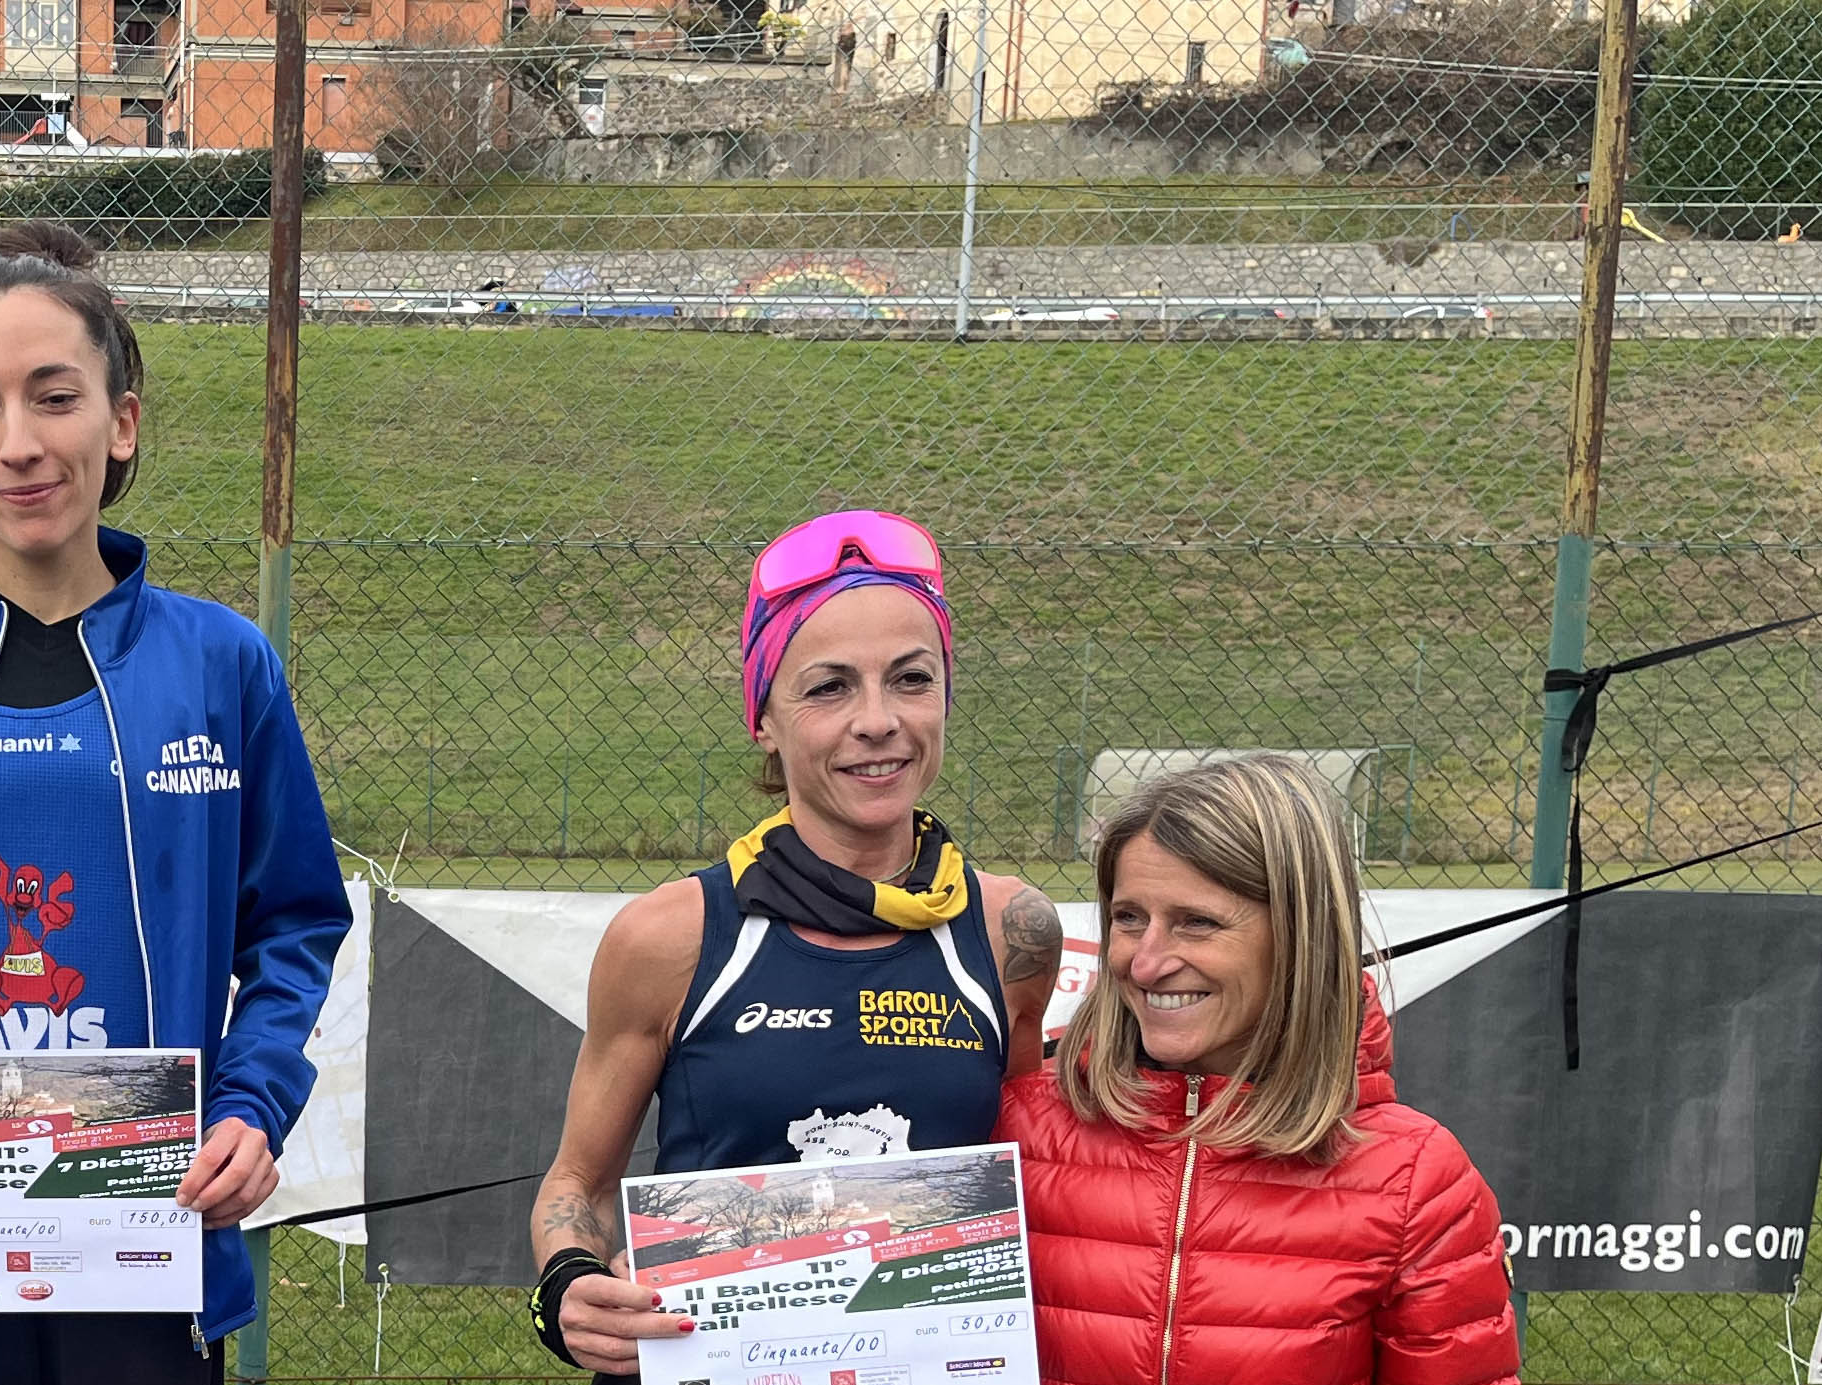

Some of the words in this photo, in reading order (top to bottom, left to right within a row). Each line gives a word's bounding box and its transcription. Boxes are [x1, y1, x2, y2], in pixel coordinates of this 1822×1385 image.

[859, 990, 948, 1016] BAROLI
[859, 1015, 942, 1036] SPORT
[861, 1034, 984, 1051] VILLENEUVE
[56, 1127, 113, 1139] MEDIUM
[135, 1120, 181, 1132] SMALL
[57, 1161, 73, 1173] 7
[89, 1216, 111, 1226] euro
[128, 1211, 189, 1229] 150,00
[956, 1218, 1003, 1233] SMALL
[874, 1231, 933, 1248] MEDIUM
[943, 1241, 1022, 1261] Domenic
[806, 1259, 847, 1274] 11°
[878, 1271, 894, 1283] 7
[685, 1287, 704, 1301] Il
[717, 1276, 858, 1298] Balcone
[712, 1293, 849, 1315] Biellese
[694, 1315, 740, 1331] ail
[916, 1326, 939, 1336] euro
[961, 1313, 1017, 1333] 50,00
[707, 1351, 731, 1360] euro
[747, 1332, 880, 1366] Cinquanta/00
